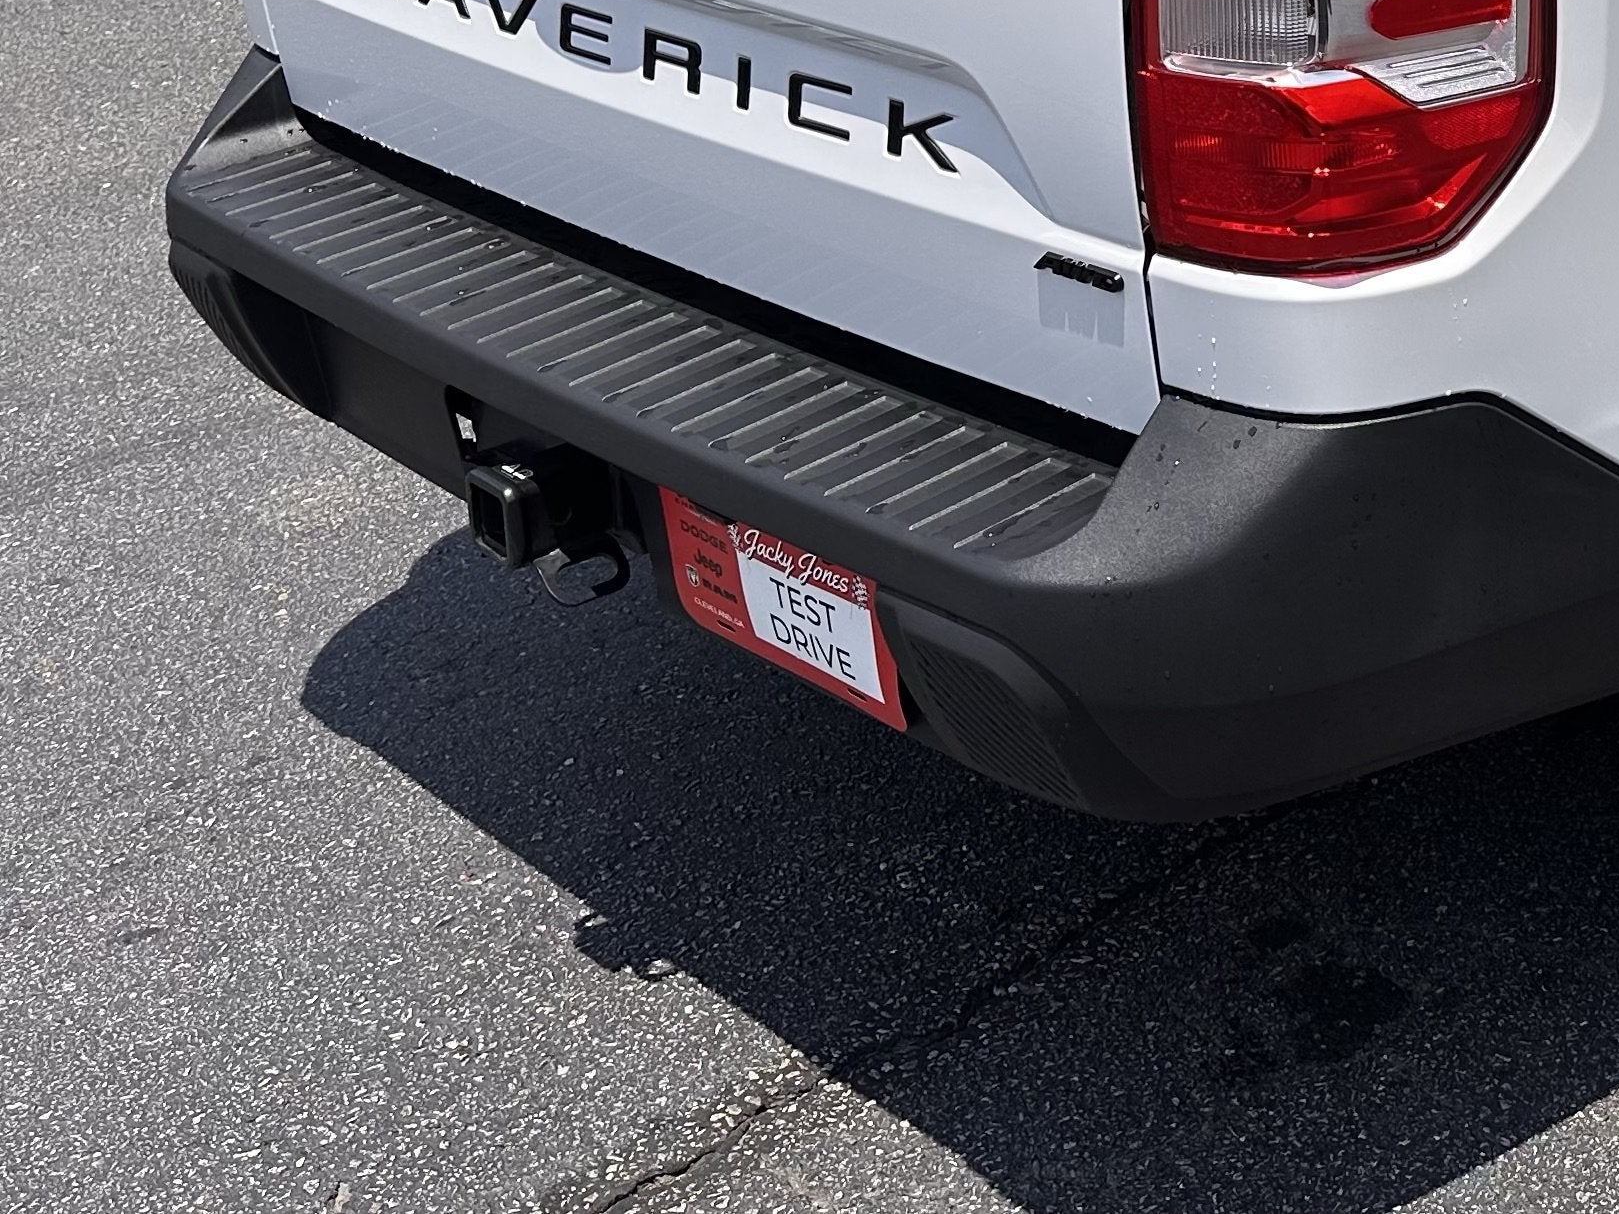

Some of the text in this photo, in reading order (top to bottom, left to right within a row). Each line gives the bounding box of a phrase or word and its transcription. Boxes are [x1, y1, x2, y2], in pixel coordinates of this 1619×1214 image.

[680, 519, 728, 554] DODGE
[694, 548, 723, 578] Jeep
[743, 529, 849, 593] Jacky Jones
[702, 577, 738, 604] RAM
[769, 576, 836, 634] TEST
[769, 612, 856, 681] DRIVE
